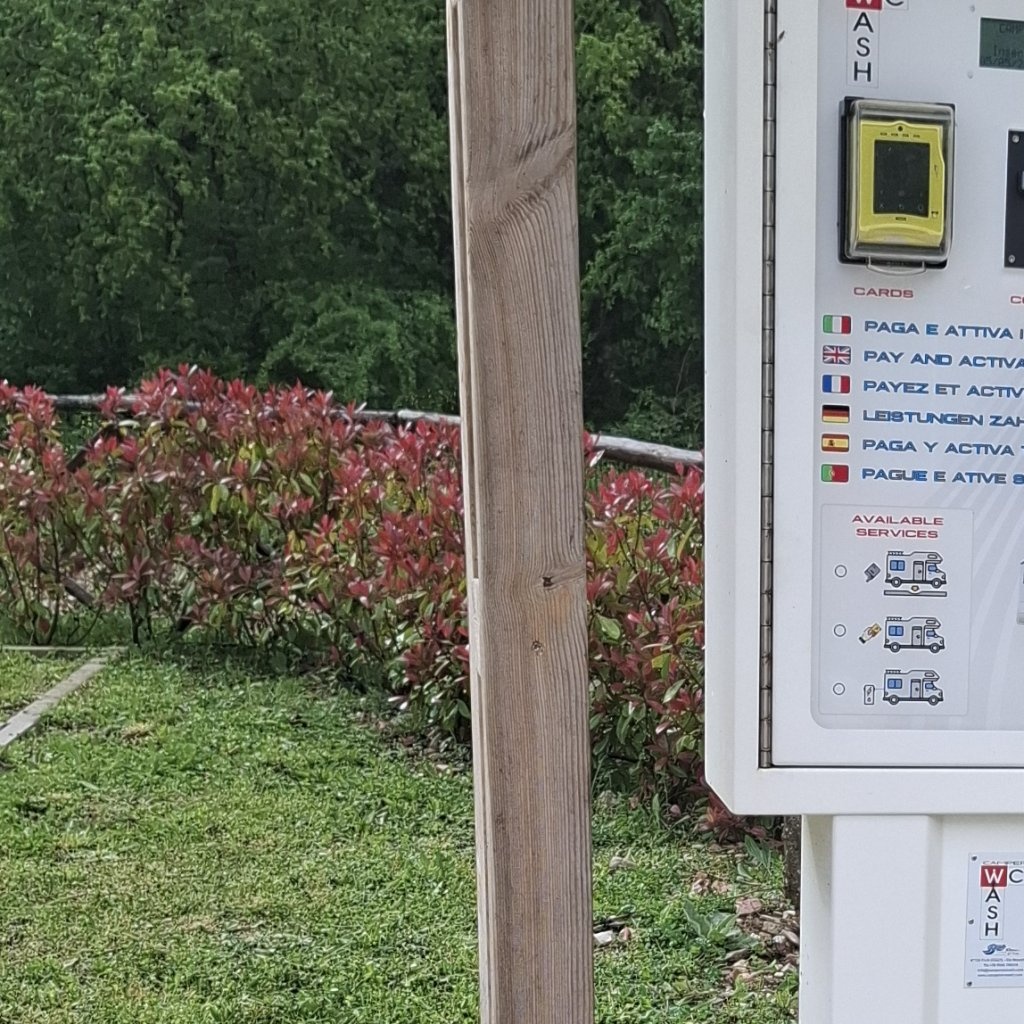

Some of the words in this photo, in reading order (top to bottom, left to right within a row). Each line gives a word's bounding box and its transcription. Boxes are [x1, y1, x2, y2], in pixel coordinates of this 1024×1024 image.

[854, 286, 914, 298] CARDS
[864, 320, 919, 335] PAGA
[926, 323, 938, 335] E
[944, 324, 1013, 339] ATTIVA
[1020, 329, 1024, 340] I
[864, 350, 904, 363] PAY
[910, 353, 952, 366] AND
[863, 380, 928, 394] PAYEZ
[935, 384, 959, 395] ET
[863, 410, 983, 426] LEISTUNGEN
[863, 440, 916, 453] PAGA
[923, 442, 938, 453] Y
[944, 443, 1014, 456] ACTIVA
[862, 469, 928, 482] PAGUE
[934, 472, 946, 482] E
[952, 473, 1006, 485] ATIVE
[852, 514, 944, 526] AVAILABLE
[856, 527, 939, 539] SERVICES
